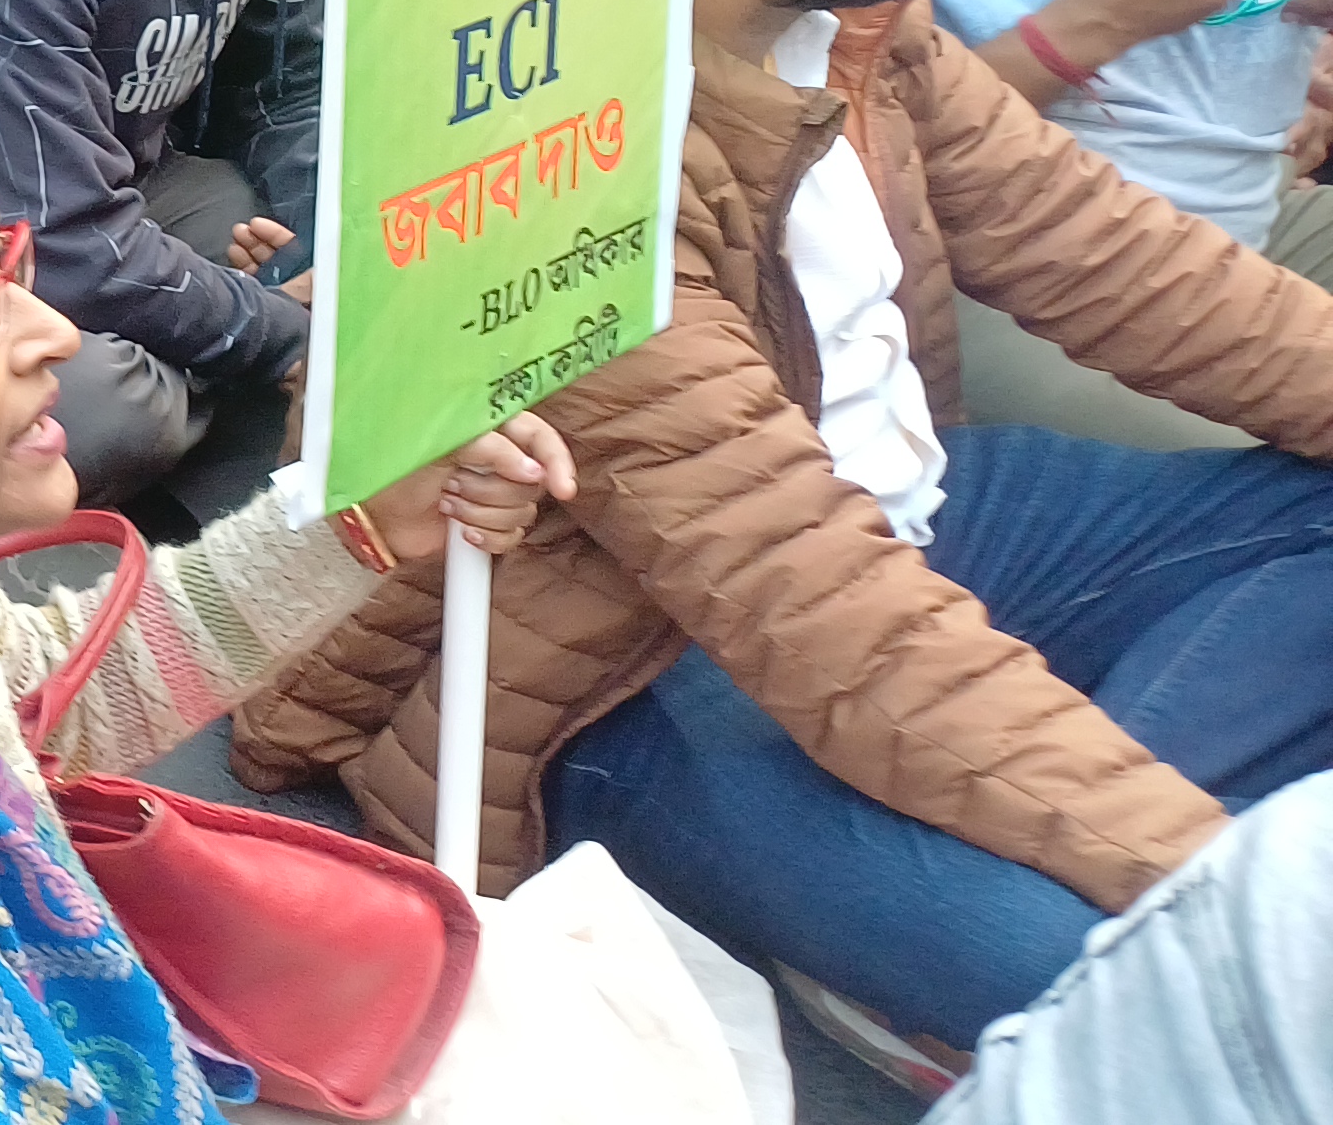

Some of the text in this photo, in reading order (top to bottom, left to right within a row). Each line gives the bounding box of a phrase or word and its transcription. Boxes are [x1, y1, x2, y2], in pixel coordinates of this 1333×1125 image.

[379, 97, 625, 269] জবাব দাও
[546, 217, 650, 291] অধিকার
[487, 303, 623, 419] রক্ষা কমিটি
